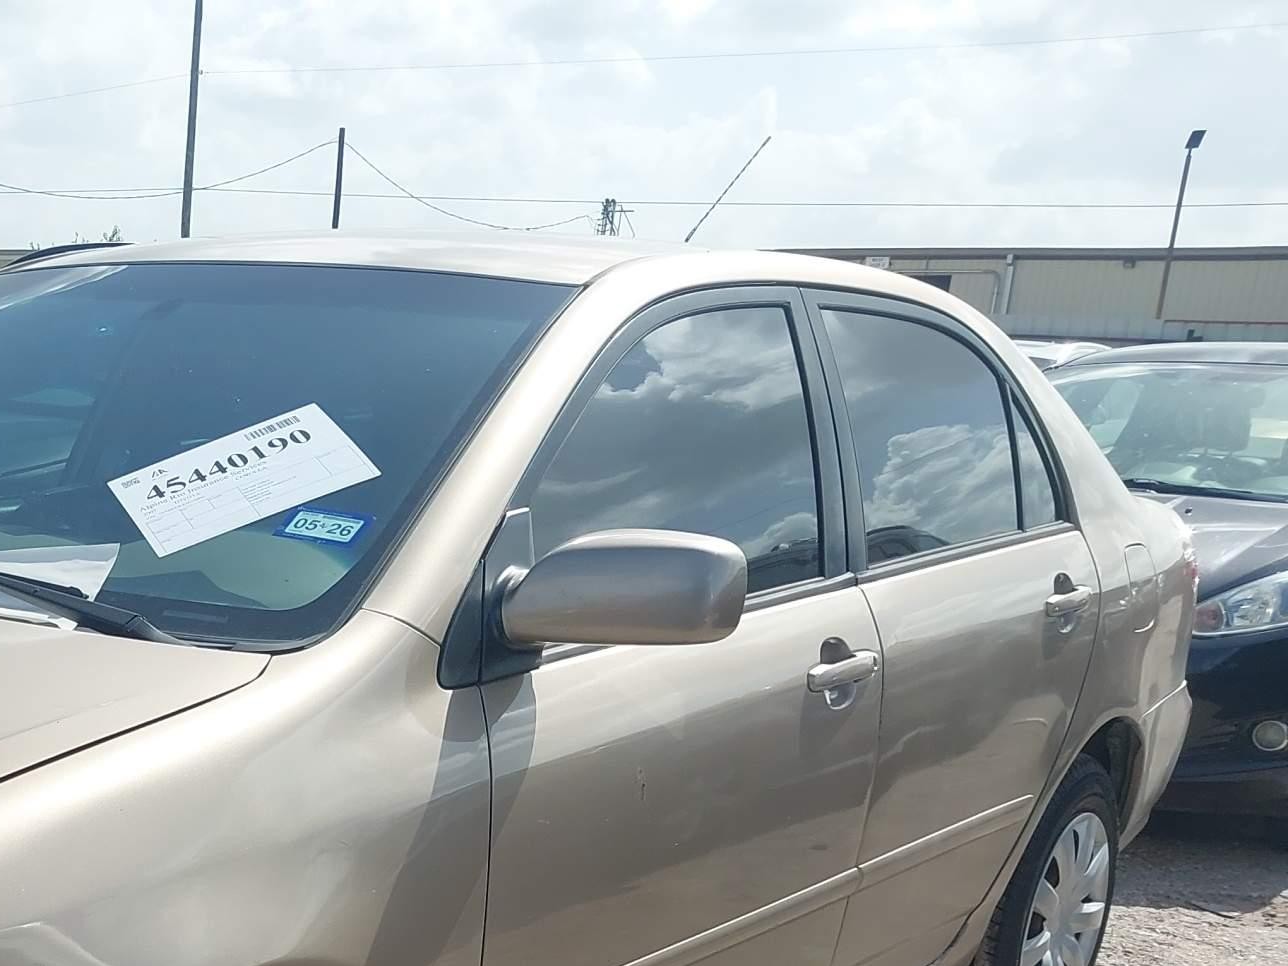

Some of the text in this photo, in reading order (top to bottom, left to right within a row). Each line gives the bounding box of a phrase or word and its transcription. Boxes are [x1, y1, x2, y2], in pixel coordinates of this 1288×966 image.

[146, 428, 312, 500] 45440190
[293, 517, 354, 537] 05 26
